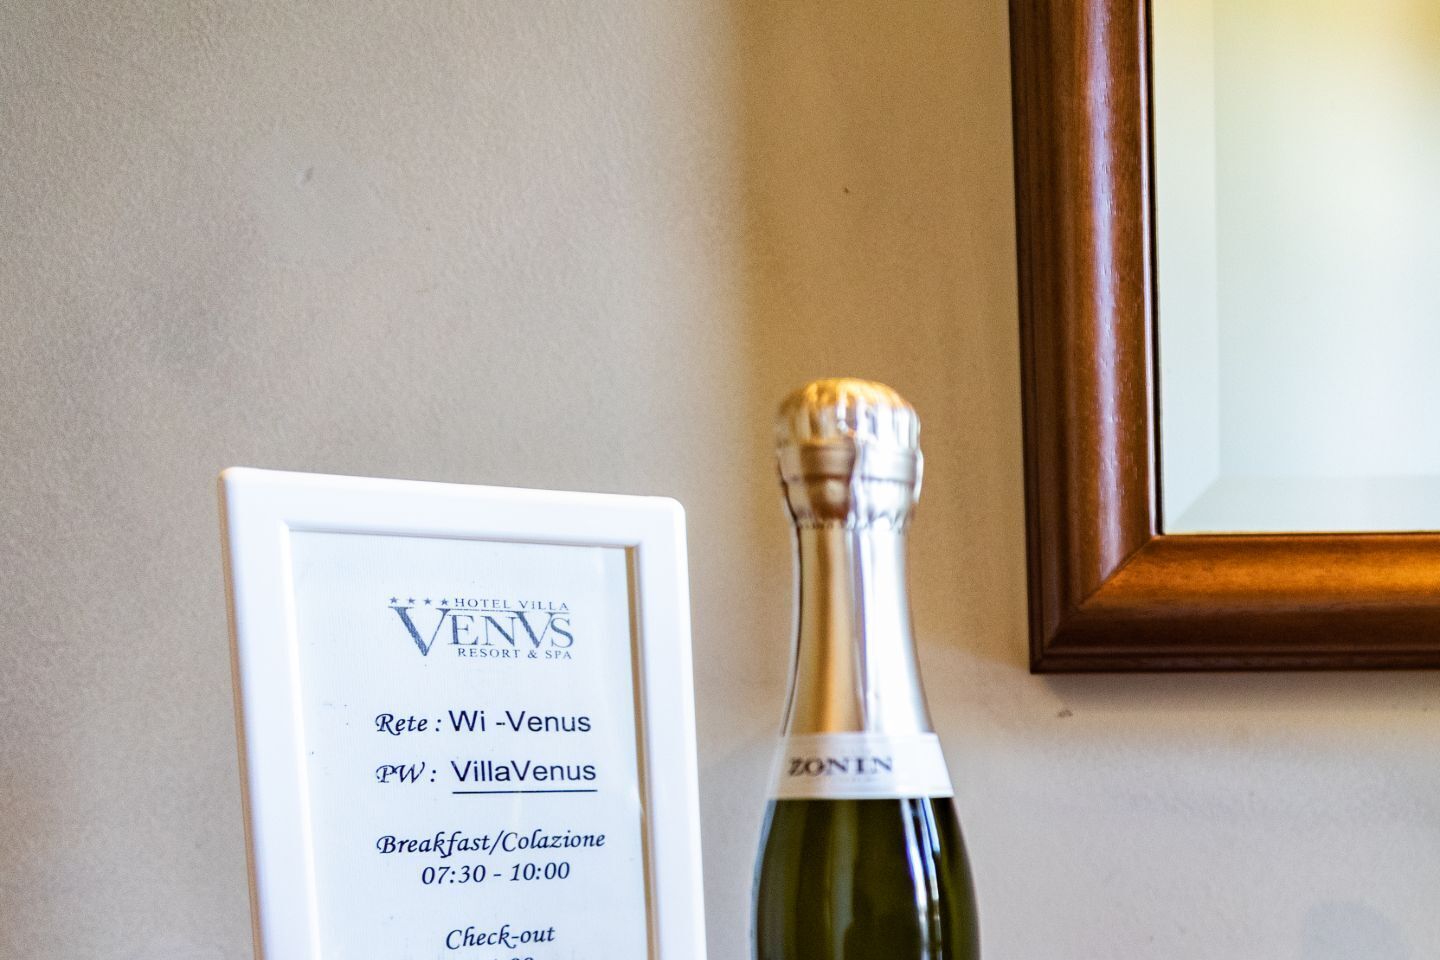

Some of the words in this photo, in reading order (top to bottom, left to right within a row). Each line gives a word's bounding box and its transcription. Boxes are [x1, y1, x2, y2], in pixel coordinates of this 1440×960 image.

[454, 598, 511, 609] HOTEL
[518, 600, 570, 611] VILLA
[457, 648, 521, 659] RESORT
[527, 650, 538, 660] &
[545, 651, 572, 660] SPA
[450, 759, 598, 783] VillaVenus
[789, 756, 892, 777] ZONIN
[376, 829, 606, 859] Breakfast/Colazione
[421, 864, 487, 885] 07:30
[509, 861, 571, 882] 10:00
[445, 924, 556, 950] Check-out
